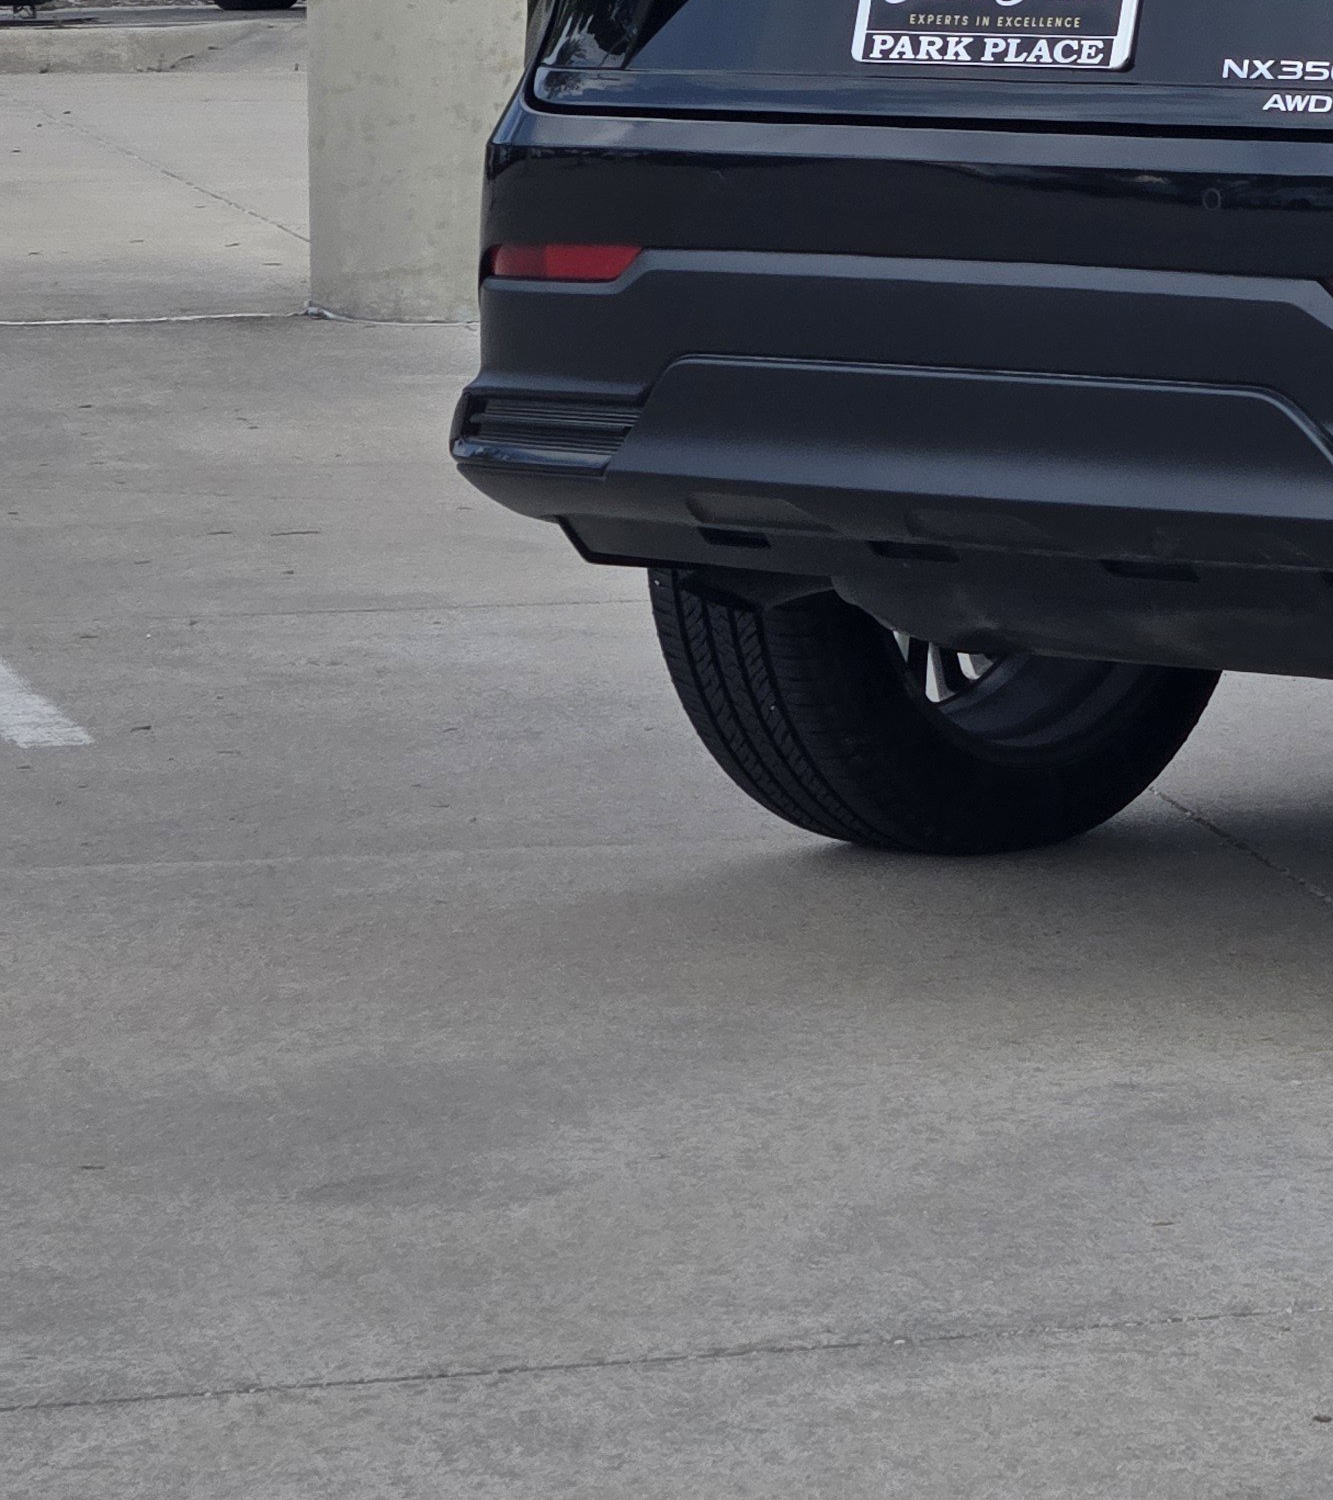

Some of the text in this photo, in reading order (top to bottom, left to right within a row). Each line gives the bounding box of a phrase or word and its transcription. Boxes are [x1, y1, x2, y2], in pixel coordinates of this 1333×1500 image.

[909, 13, 1082, 29] EXPERTS IN EXCELLENCE
[869, 34, 1104, 66] PARK PLACE
[1262, 93, 1333, 113] AWD
